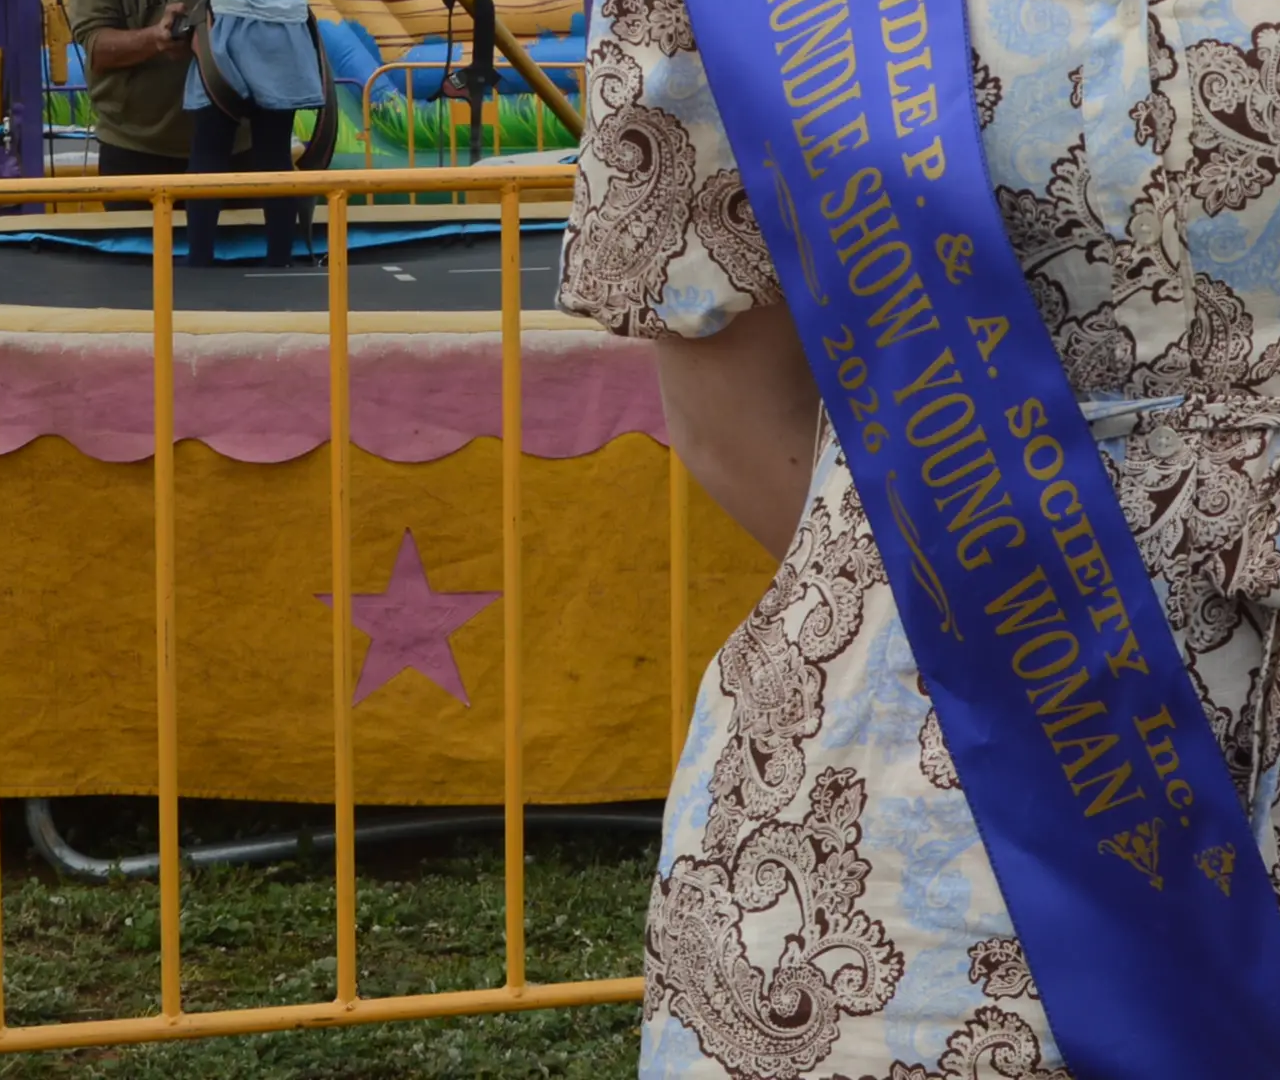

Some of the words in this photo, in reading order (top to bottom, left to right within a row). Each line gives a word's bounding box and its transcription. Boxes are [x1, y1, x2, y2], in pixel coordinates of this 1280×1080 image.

[820, 166, 941, 349] SHOW
[892, 346, 1028, 572] YOUNG
[984, 564, 1148, 819] WOMAN
[822, 324, 890, 455] 2026
[902, 137, 946, 207] P.
[934, 232, 975, 285] &
[966, 315, 1011, 379] A.
[1005, 396, 1151, 680] SOCIETY
[1133, 703, 1196, 829] Inc.
